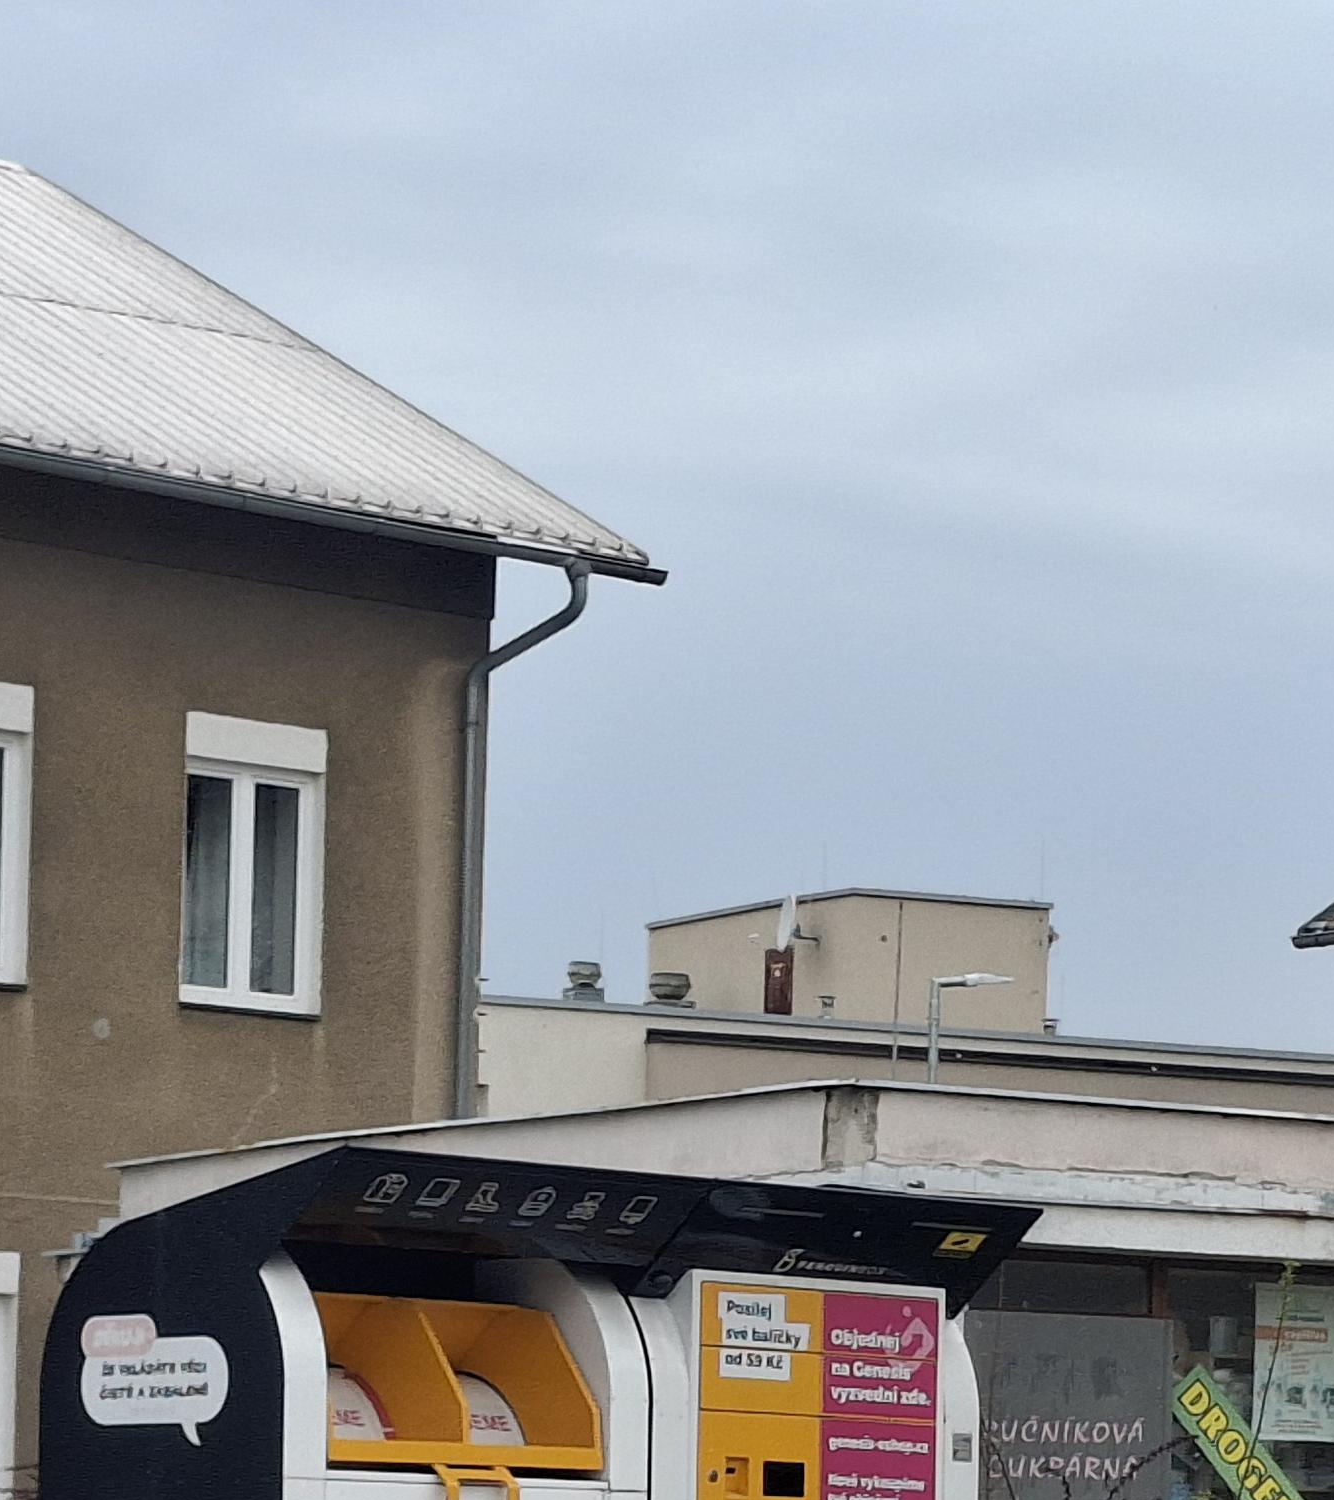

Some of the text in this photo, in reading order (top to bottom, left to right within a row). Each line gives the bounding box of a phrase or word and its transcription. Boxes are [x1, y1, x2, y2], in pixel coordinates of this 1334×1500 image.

[831, 1328, 900, 1353] Objednej
[725, 1353, 742, 1365] od
[831, 1361, 910, 1380] na Genesis
